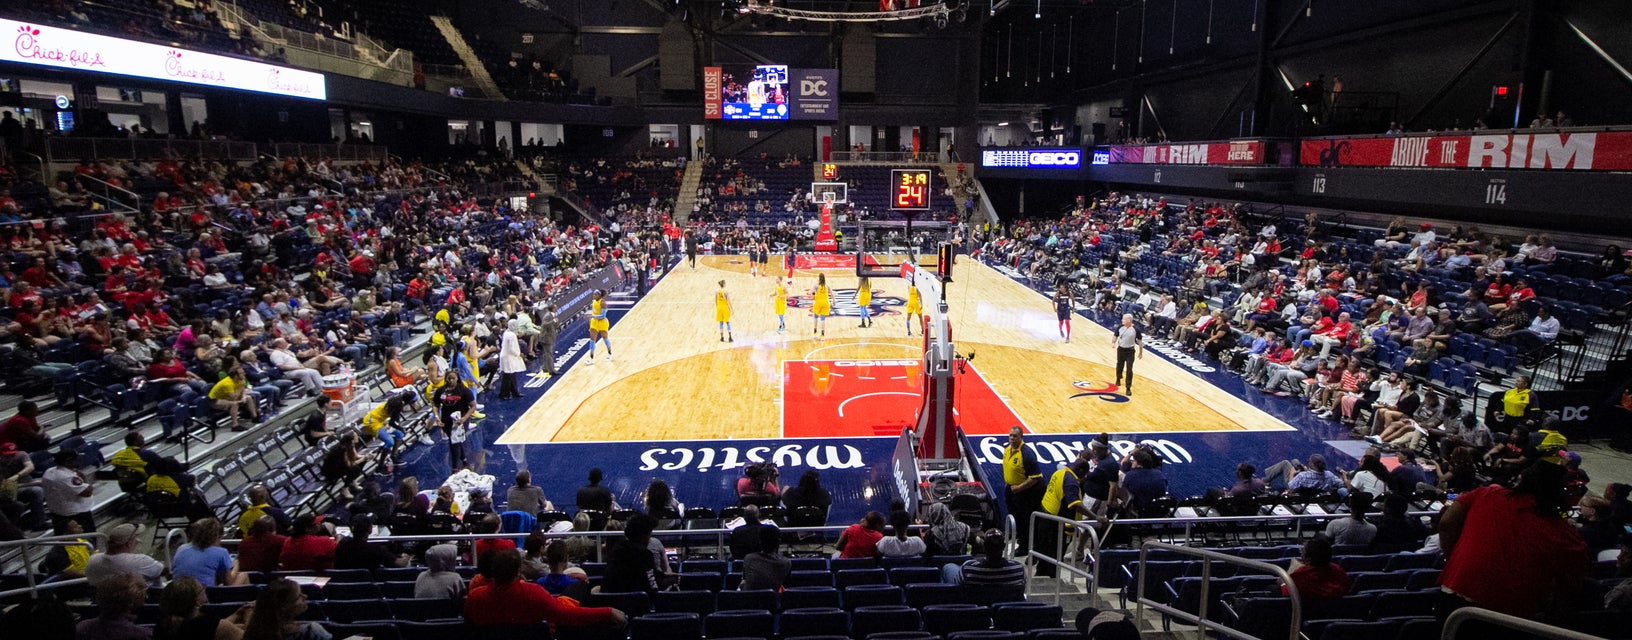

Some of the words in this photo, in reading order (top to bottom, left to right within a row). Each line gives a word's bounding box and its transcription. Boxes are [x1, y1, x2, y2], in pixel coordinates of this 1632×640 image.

[521, 35, 534, 43] 207
[16, 30, 105, 67] Chick-fil-A
[165, 54, 226, 82] Chick-fil-A
[704, 71, 718, 100] CLOSE
[800, 79, 828, 97] DC
[705, 103, 718, 115] SO
[1029, 152, 1080, 166] GEICO
[1168, 144, 1209, 164] RIM
[1228, 151, 1254, 161] HERE
[1390, 137, 1431, 166] ABOVE
[1441, 140, 1458, 164] THE
[1467, 132, 1597, 169] RIM
[902, 173, 927, 185] 3:19
[1312, 177, 1326, 193] 113
[898, 185, 922, 206] 24
[1485, 184, 1506, 205] 114
[1561, 405, 1590, 421] DC
